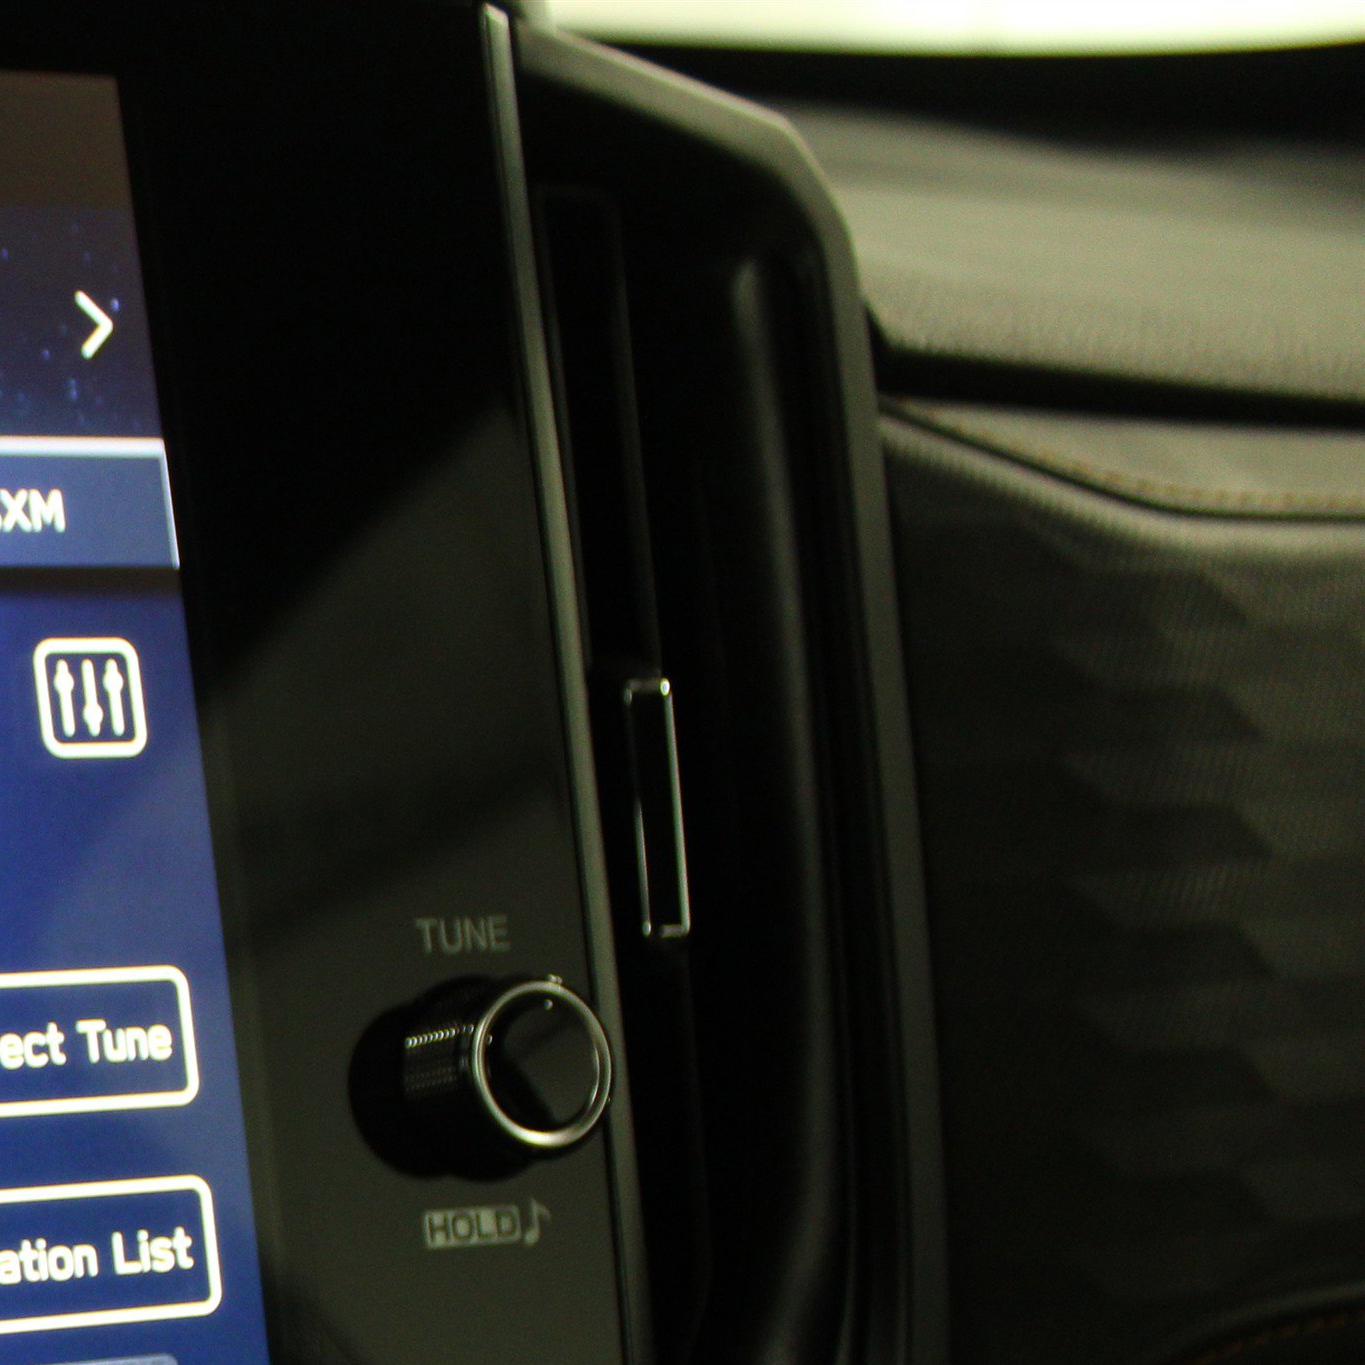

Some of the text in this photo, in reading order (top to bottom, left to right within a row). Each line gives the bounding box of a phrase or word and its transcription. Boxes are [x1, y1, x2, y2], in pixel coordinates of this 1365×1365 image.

[414, 914, 510, 954] TUNE
[76, 1018, 173, 1064] Tune
[427, 1208, 518, 1246] HOLD
[112, 1226, 194, 1273] List
